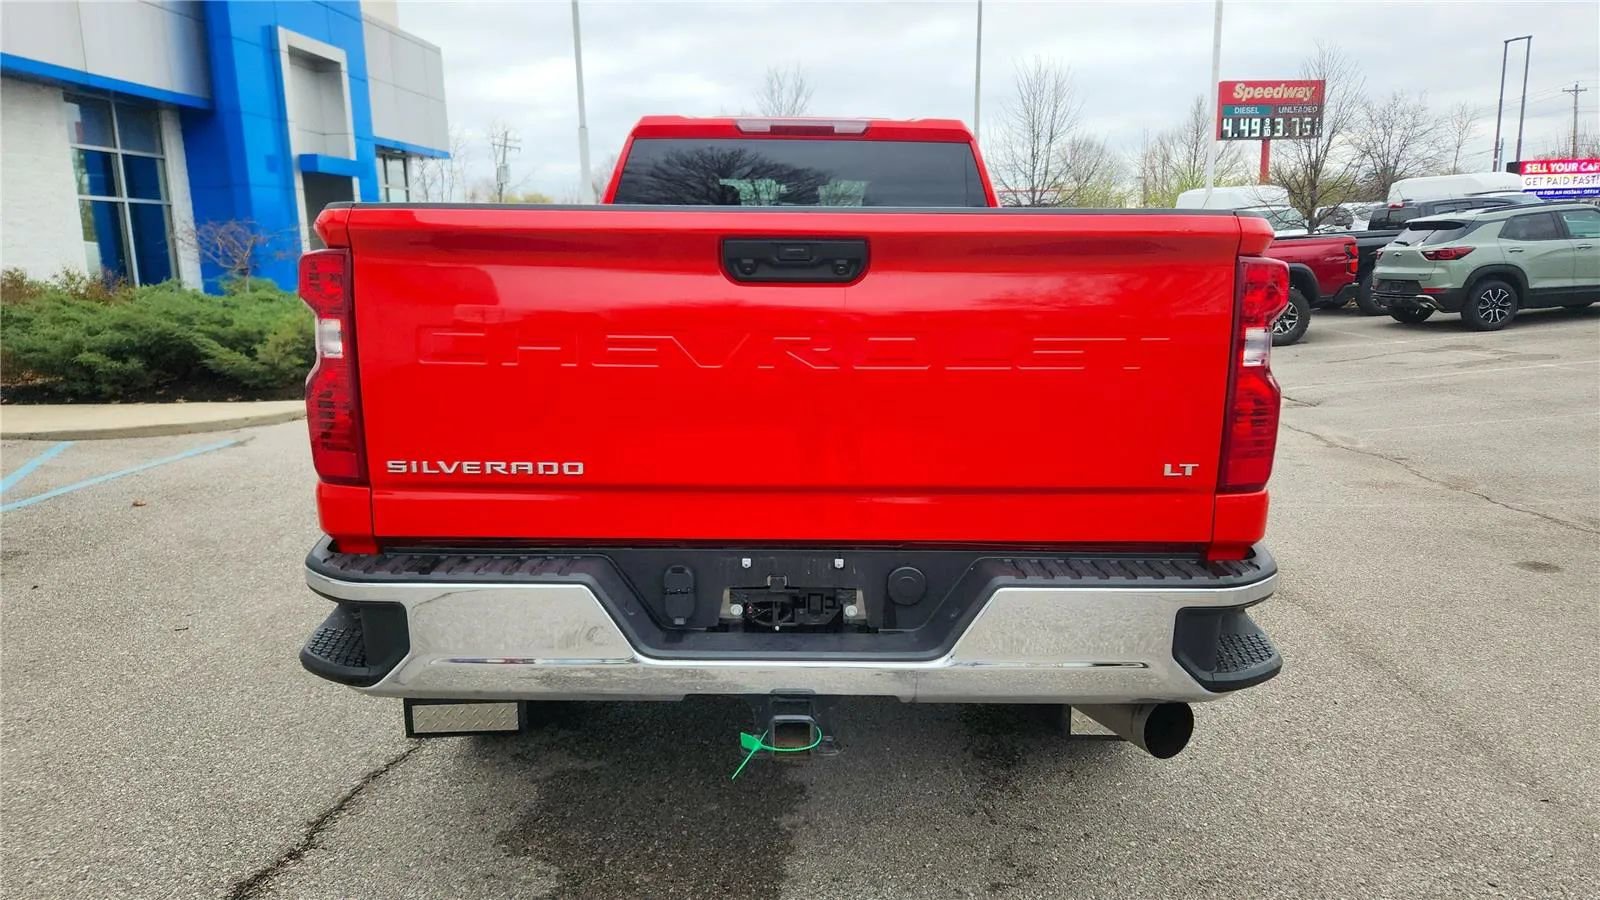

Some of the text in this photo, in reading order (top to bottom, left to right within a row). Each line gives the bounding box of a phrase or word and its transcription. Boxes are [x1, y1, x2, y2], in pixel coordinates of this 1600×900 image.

[1233, 83, 1316, 101] Speedway
[1234, 106, 1260, 114] DIESEL
[1278, 105, 1318, 114] UNLEADED
[1223, 118, 1261, 137] 4.49
[1525, 163, 1548, 172] SELL
[1550, 162, 1578, 172] YOUR
[1525, 177, 1543, 186] GET
[1547, 176, 1569, 185] PAID
[416, 325, 1171, 370] CHEVROLET
[386, 460, 585, 476] SILVERADO
[1163, 463, 1200, 477] LT
